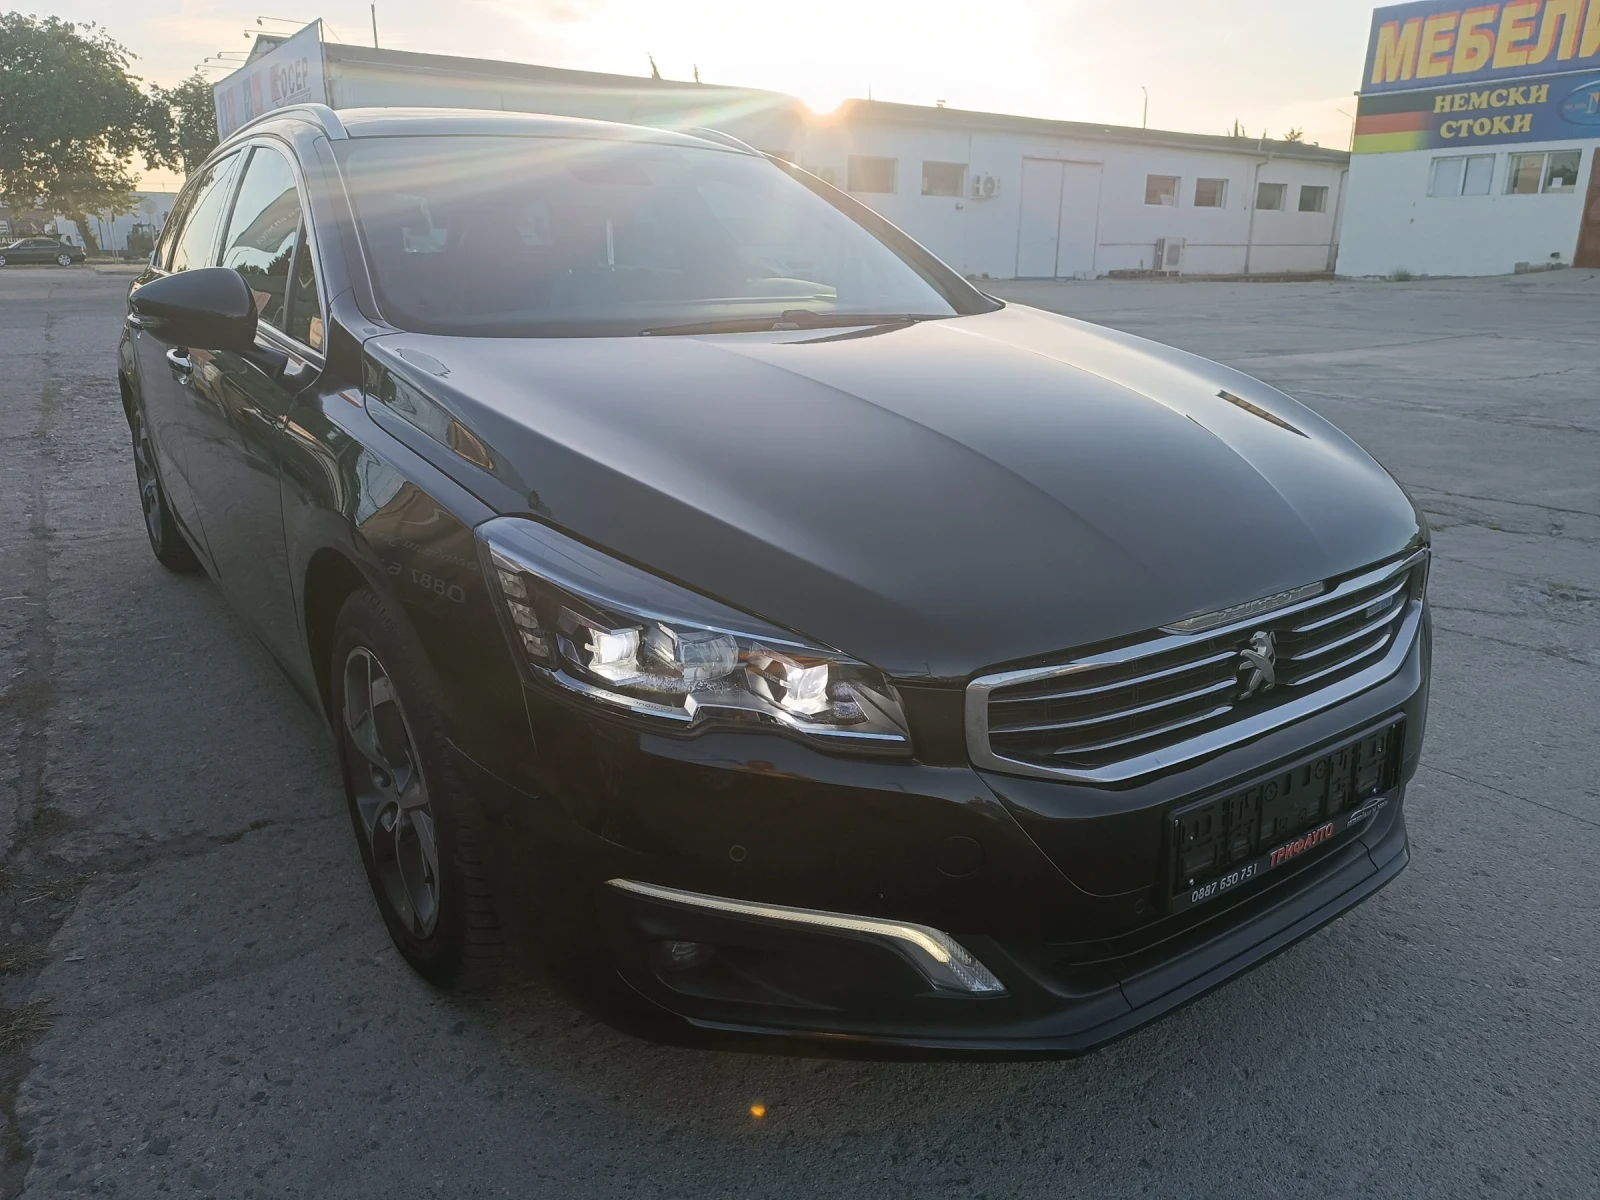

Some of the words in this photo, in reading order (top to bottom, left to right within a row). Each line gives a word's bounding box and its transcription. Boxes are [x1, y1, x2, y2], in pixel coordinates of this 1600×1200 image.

[1433, 84, 1550, 113] НЕМСКИ
[1440, 113, 1533, 138] СТОКИ
[1191, 882, 1216, 903] 0887
[1219, 872, 1238, 891] 650
[1240, 863, 1258, 882] 751
